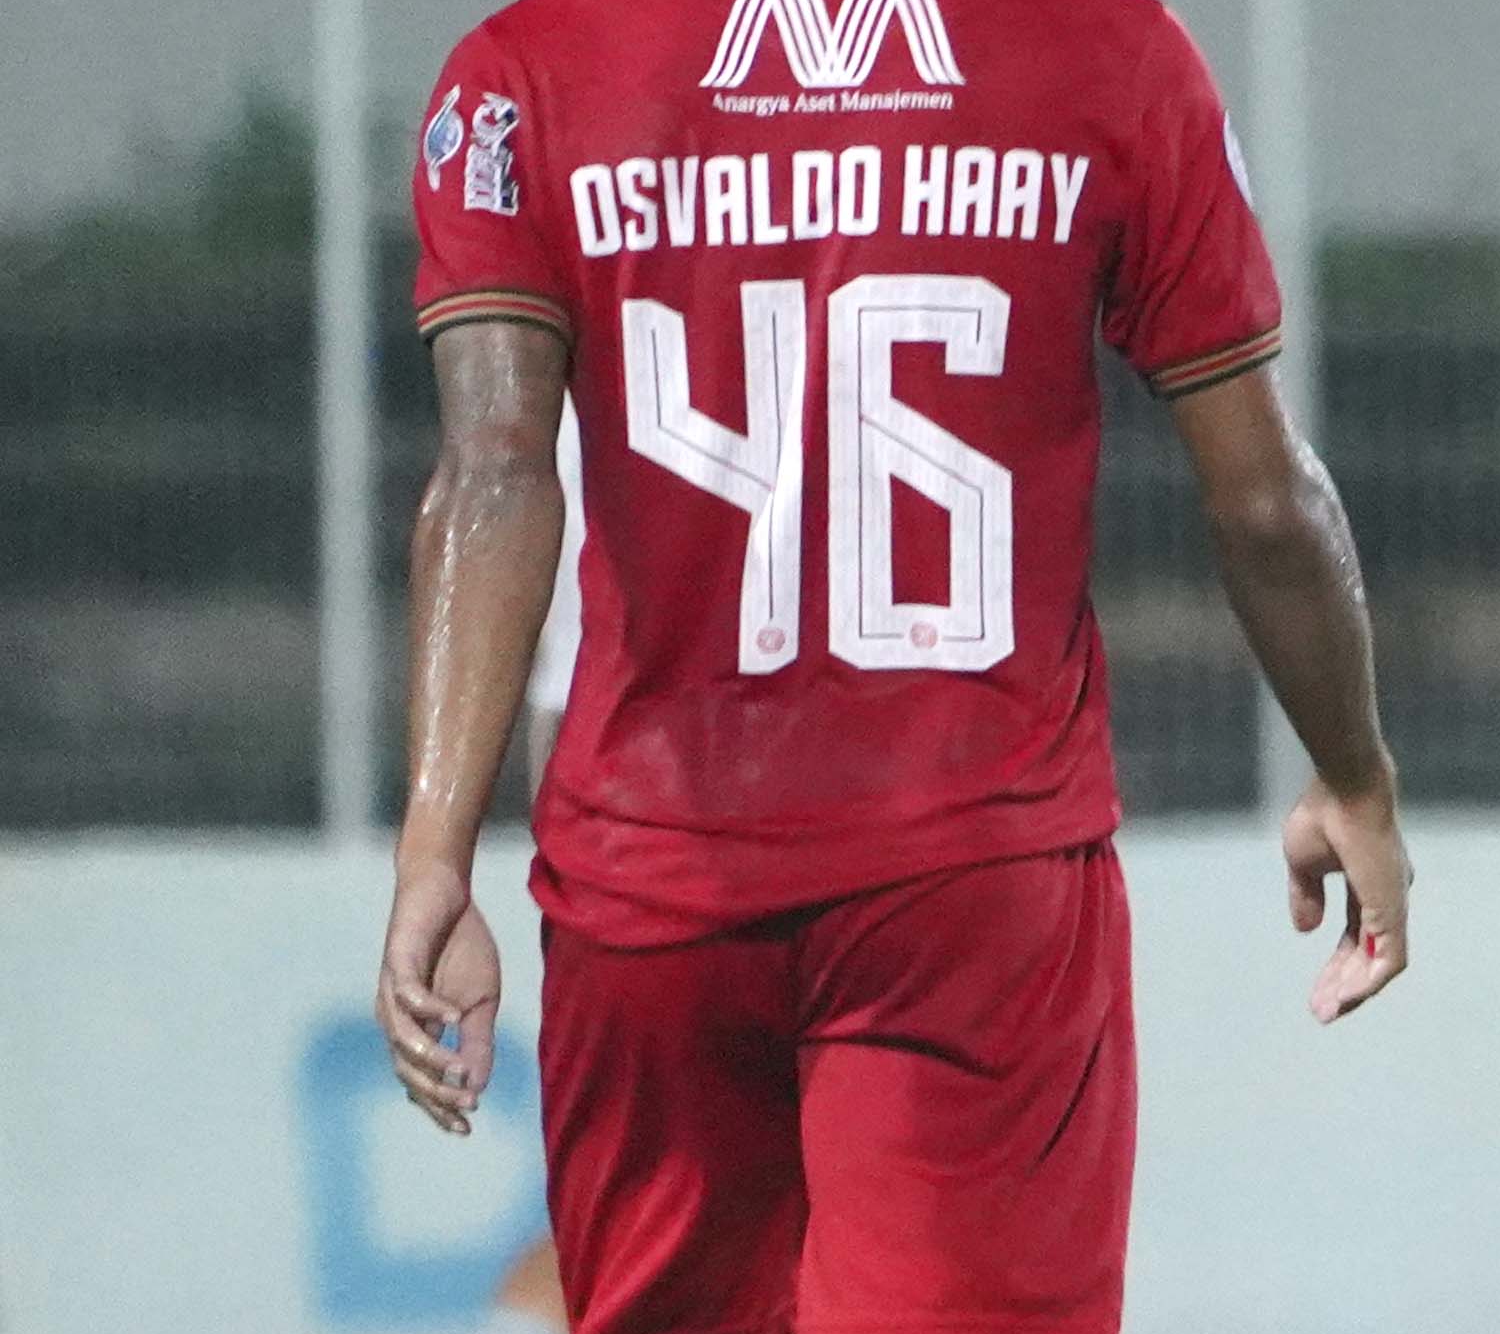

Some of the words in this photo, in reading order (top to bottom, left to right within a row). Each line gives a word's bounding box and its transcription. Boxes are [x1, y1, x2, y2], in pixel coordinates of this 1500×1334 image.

[712, 92, 791, 117] Anargya
[793, 92, 836, 113] Aset
[569, 145, 882, 257] OSVALDO
[901, 144, 1091, 243] HAAY
[621, 273, 1015, 675] 46
